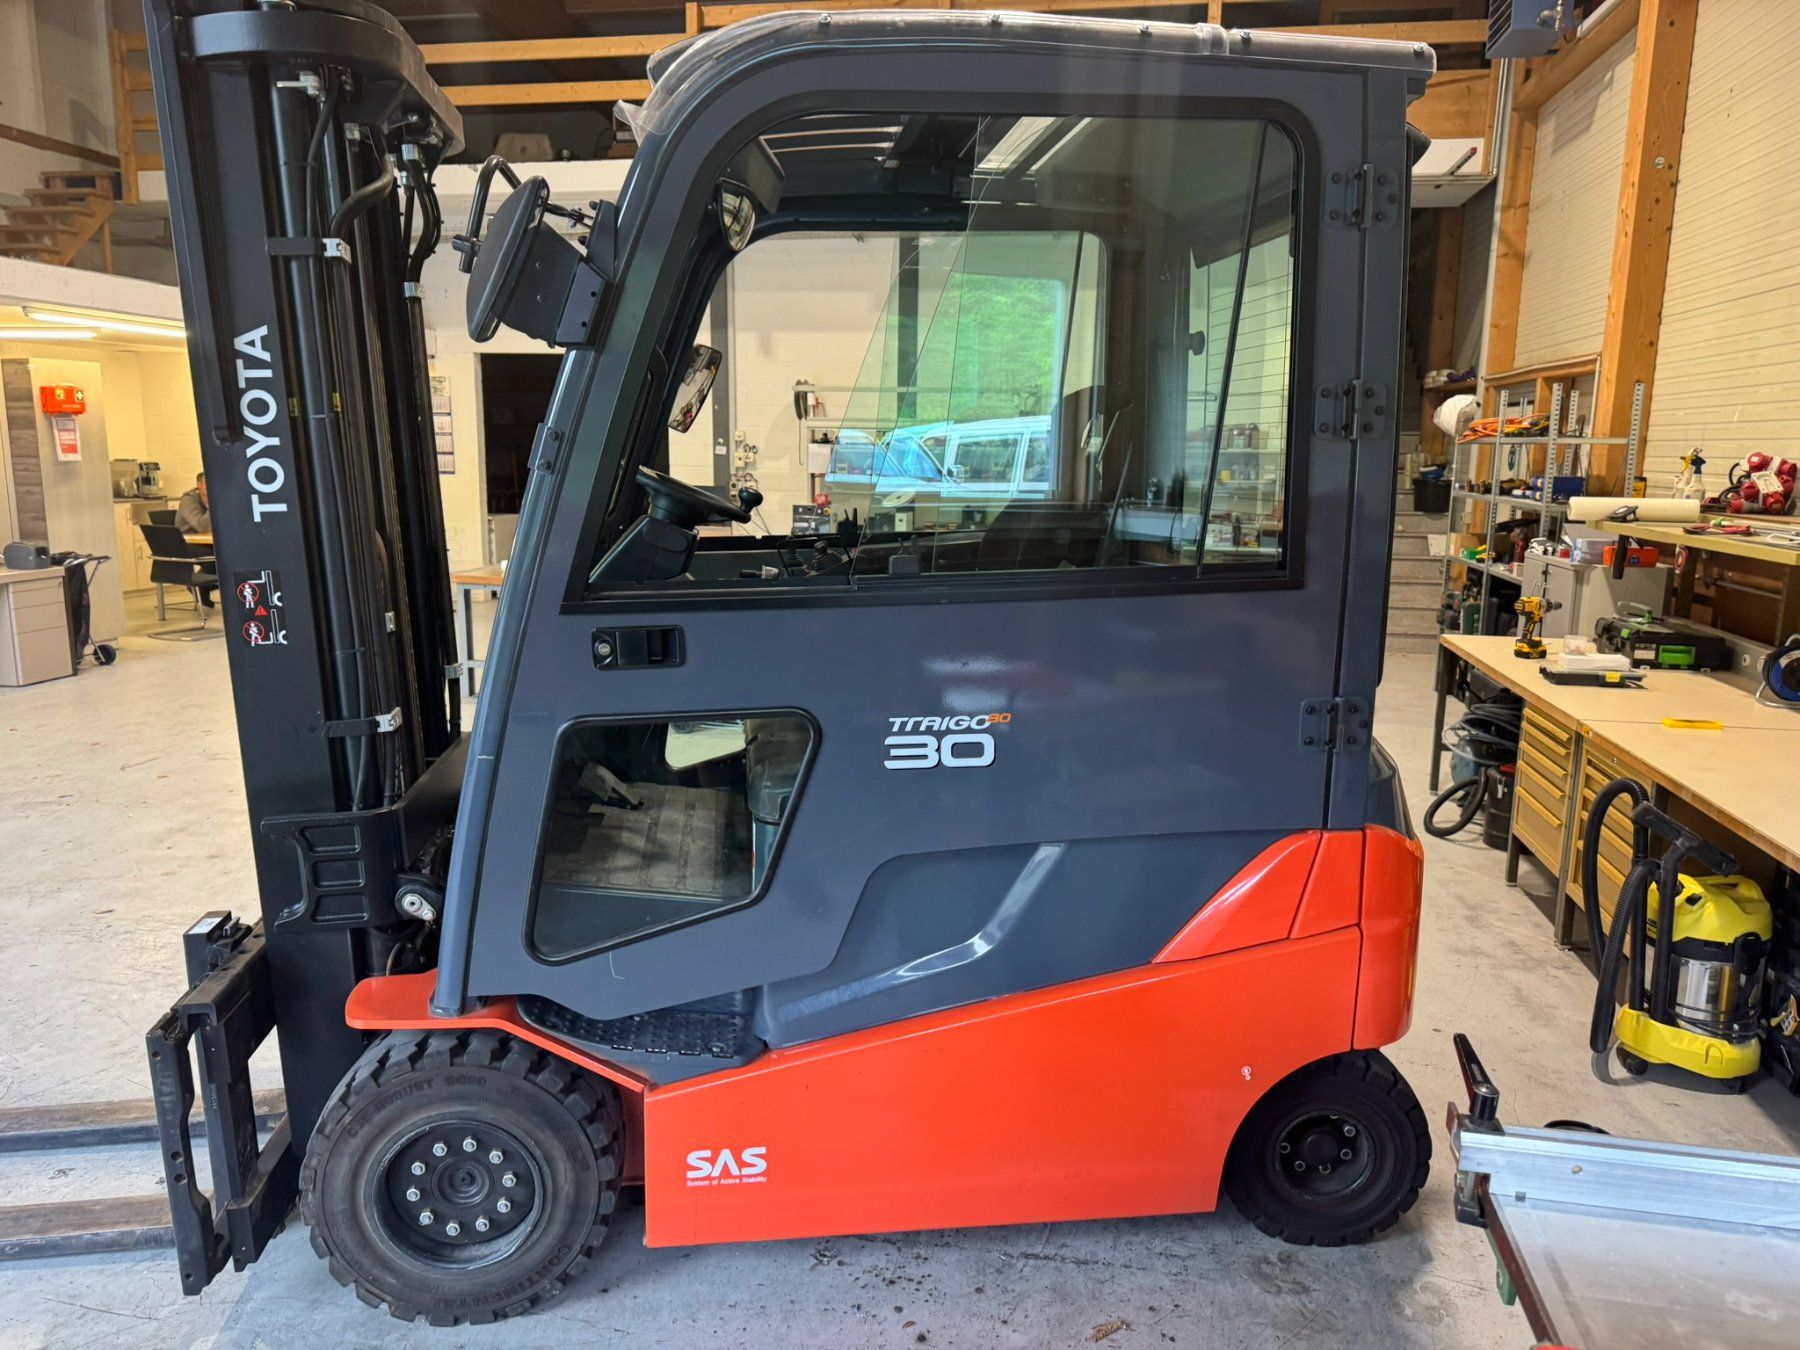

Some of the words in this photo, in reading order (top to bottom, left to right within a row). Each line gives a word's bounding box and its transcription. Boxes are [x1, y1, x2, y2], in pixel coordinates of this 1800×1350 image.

[233, 324, 288, 522] TOYOTA
[888, 715, 992, 732] TRAIGO
[883, 733, 996, 770] 30
[686, 1146, 768, 1178] SAS
[686, 1179, 710, 1187] System
[711, 1178, 719, 1186] of
[720, 1178, 740, 1186] Active
[741, 1176, 768, 1184] Stability
